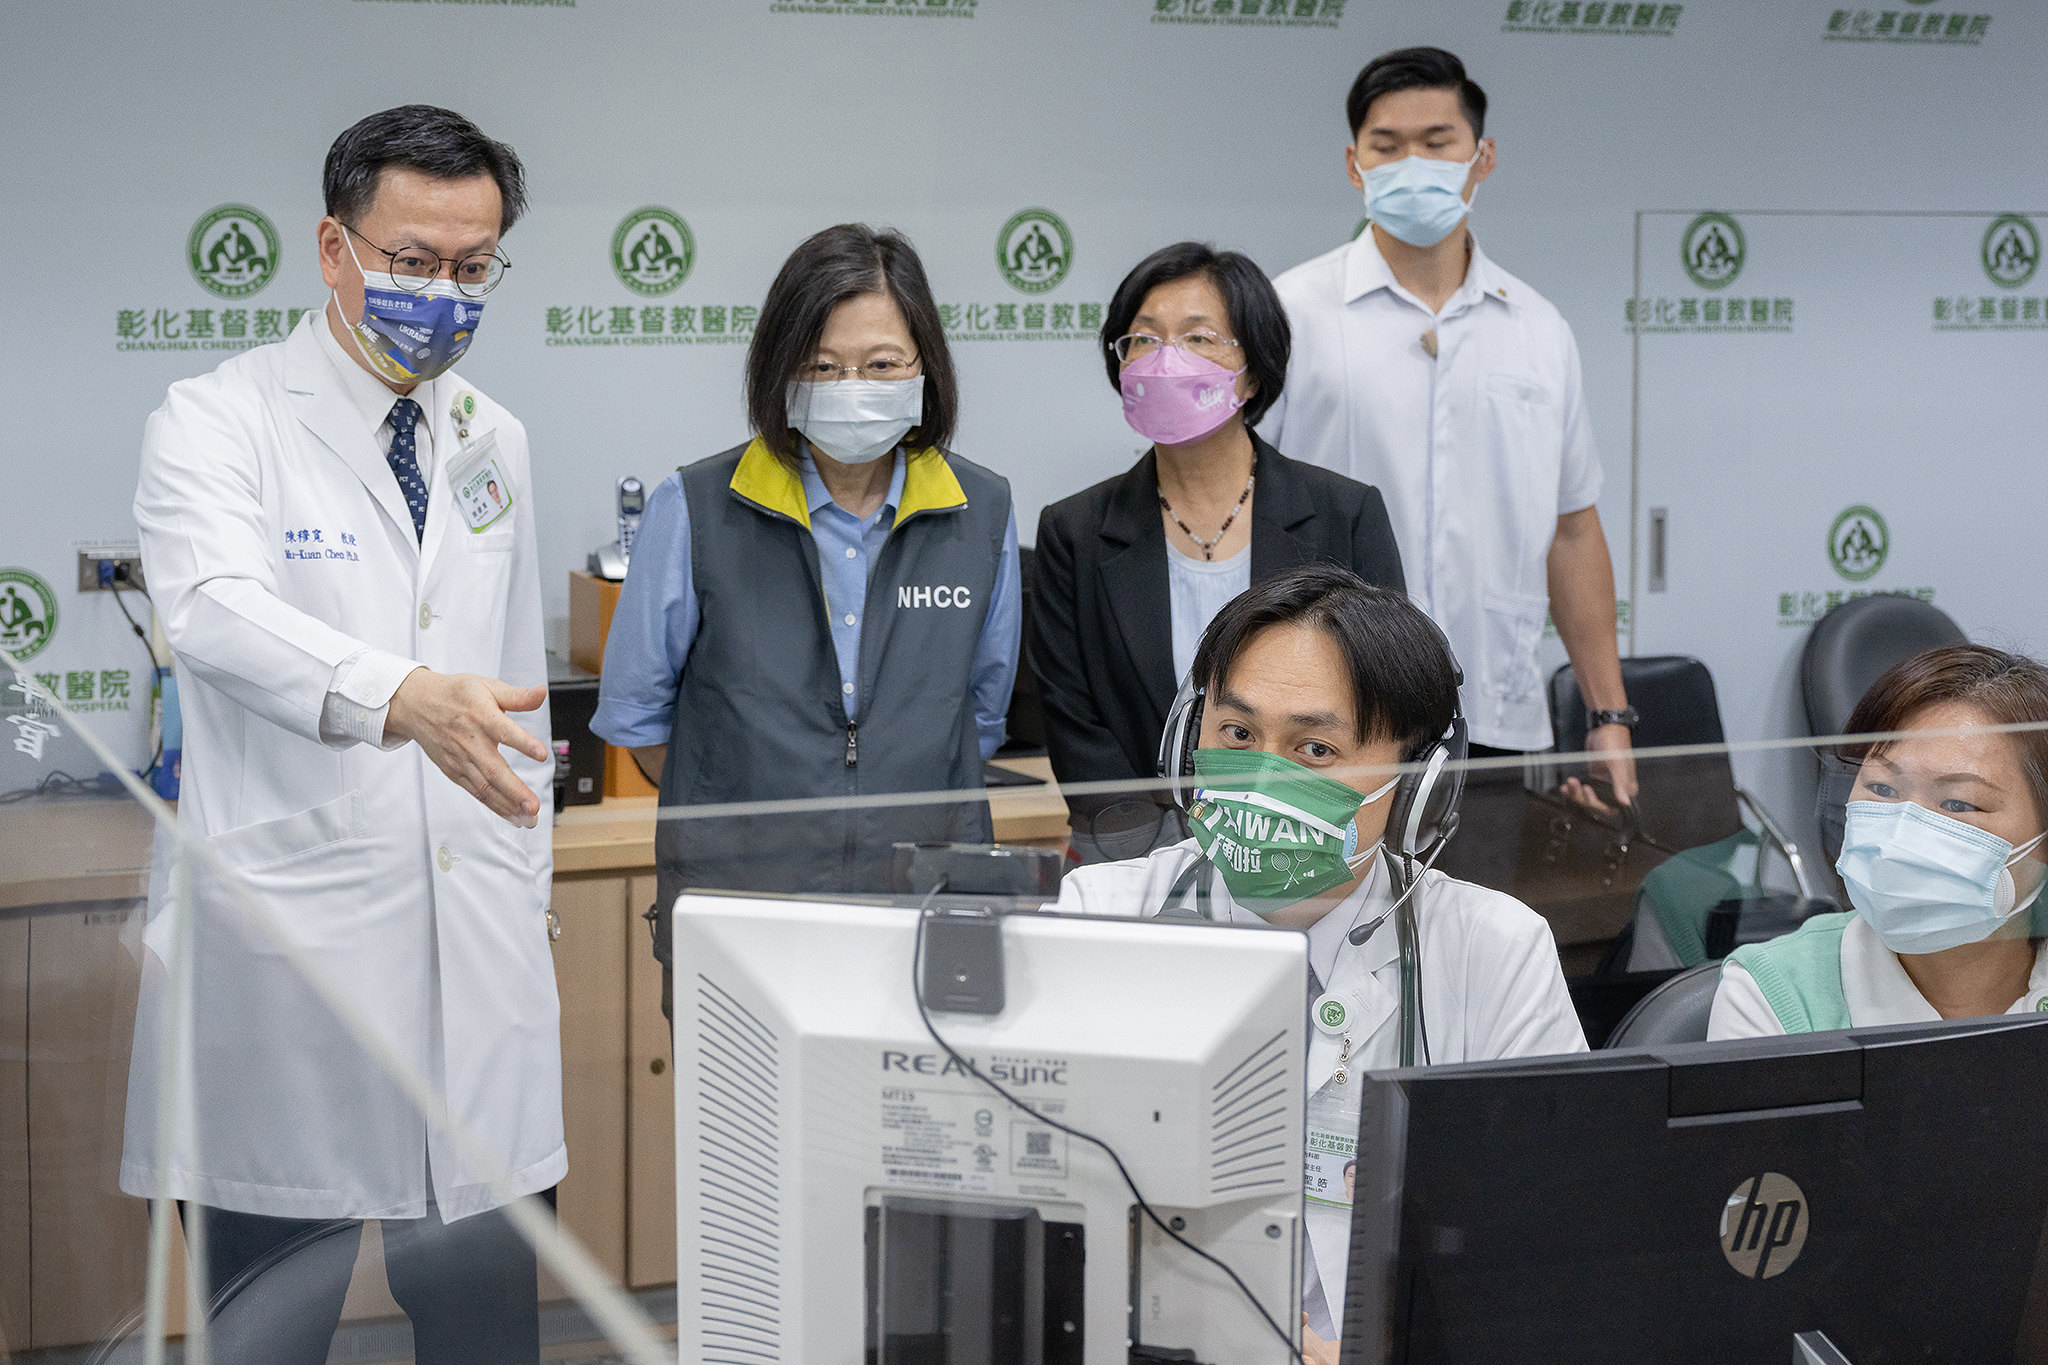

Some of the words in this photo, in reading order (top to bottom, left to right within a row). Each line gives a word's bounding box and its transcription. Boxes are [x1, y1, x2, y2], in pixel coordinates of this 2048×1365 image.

[545, 305, 758, 335] 彰化基督教醫院
[938, 302, 1110, 331] 彰化基督教醫
[1934, 297, 2048, 320] 彰化基督教
[399, 324, 431, 343] UKRAINE
[695, 335, 751, 345] HOSPITA
[897, 585, 971, 609] NHCC
[1222, 805, 1325, 846] AIWAN
[1730, 1172, 1801, 1280] hp
